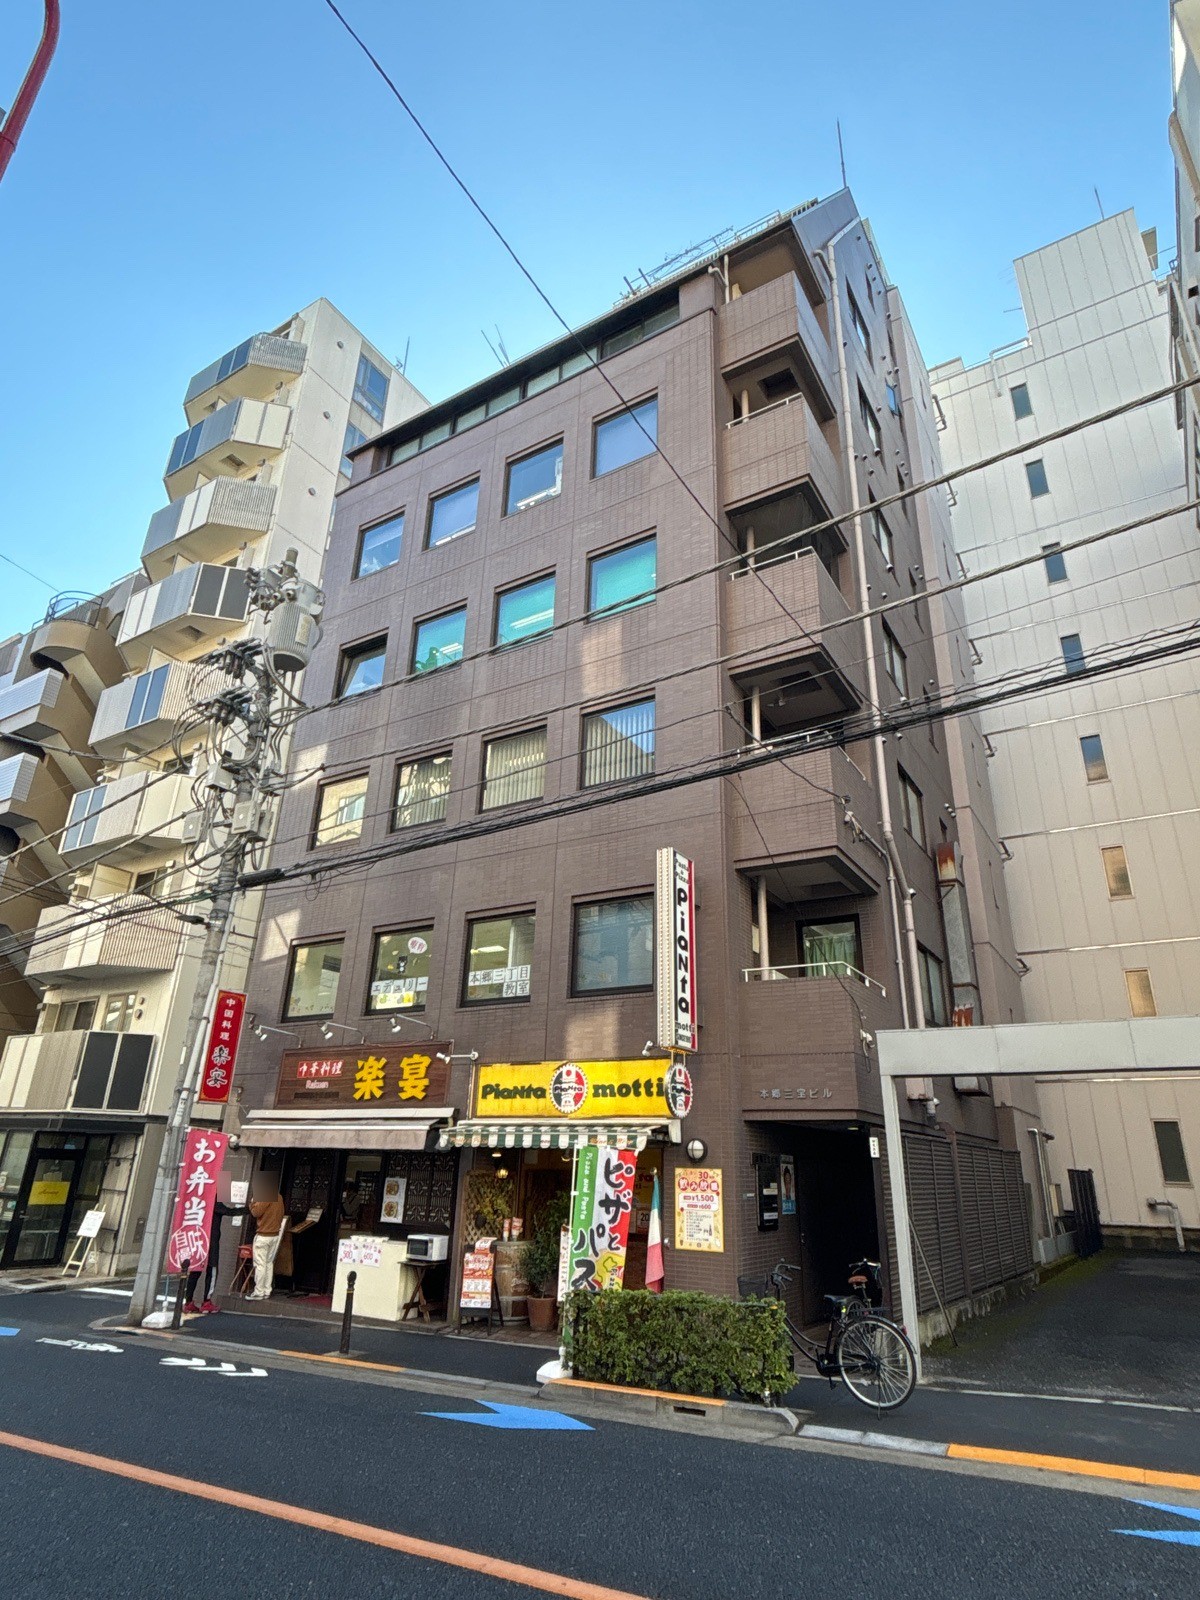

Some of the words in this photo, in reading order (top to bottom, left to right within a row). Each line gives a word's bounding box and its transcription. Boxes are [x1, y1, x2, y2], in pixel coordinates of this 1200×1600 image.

[373, 978, 427, 993] エデュリー
[470, 966, 530, 985] 本郷三丁目
[504, 981, 530, 997] 教室
[220, 998, 236, 1041] 中国料理
[299, 1060, 343, 1076] 中華料理
[353, 1053, 432, 1101] 楽宴
[592, 1077, 664, 1099] motti
[760, 1088, 832, 1099] 本郷三宝ビル
[182, 1138, 221, 1226] お弁当
[580, 1197, 589, 1220] Pasta
